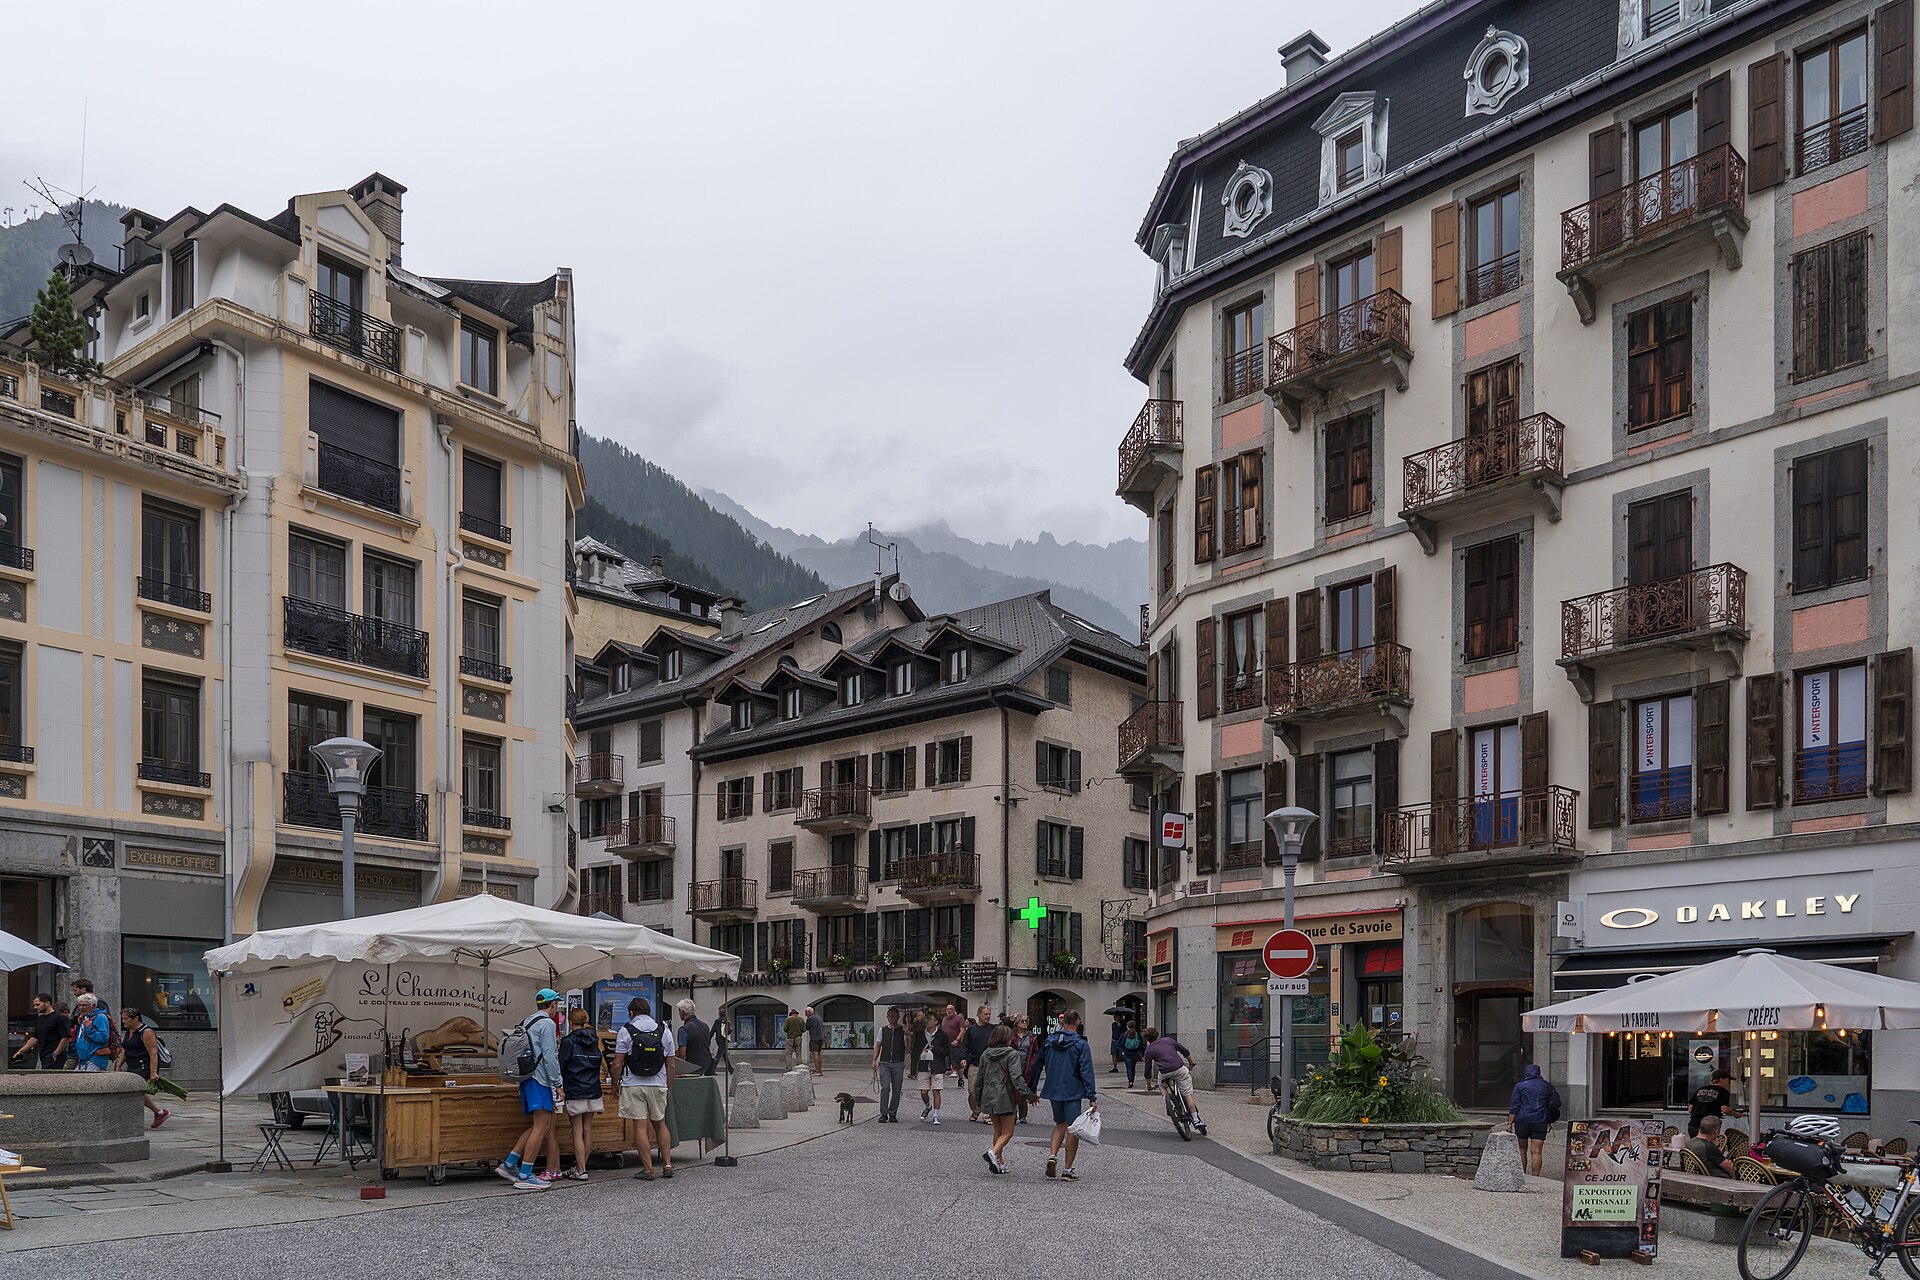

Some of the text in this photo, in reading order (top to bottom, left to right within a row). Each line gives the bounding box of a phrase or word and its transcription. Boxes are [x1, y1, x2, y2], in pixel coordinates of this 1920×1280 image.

[1811, 678, 1820, 733] INTERSPORT
[130, 850, 216, 870] EXCHANGE OFFICE
[289, 866, 332, 880] BANQUE
[354, 872, 393, 886] HAMONIX
[1676, 894, 1860, 923] OAKLEY
[1330, 923, 1345, 936] de
[1349, 920, 1393, 934] Savoie
[807, 970, 826, 984] DU
[844, 967, 888, 983] MONT
[907, 964, 960, 980] BLANC
[359, 969, 394, 996] Le
[396, 971, 512, 1007] Chamoniard
[1538, 1014, 1558, 1029] BURGER
[1621, 1012, 1660, 1028] LA FABRICA
[1032, 1025, 1042, 1035] du
[1585, 1174, 1627, 1182] CE JOUR
[1578, 1188, 1632, 1196] EXPOSITION
